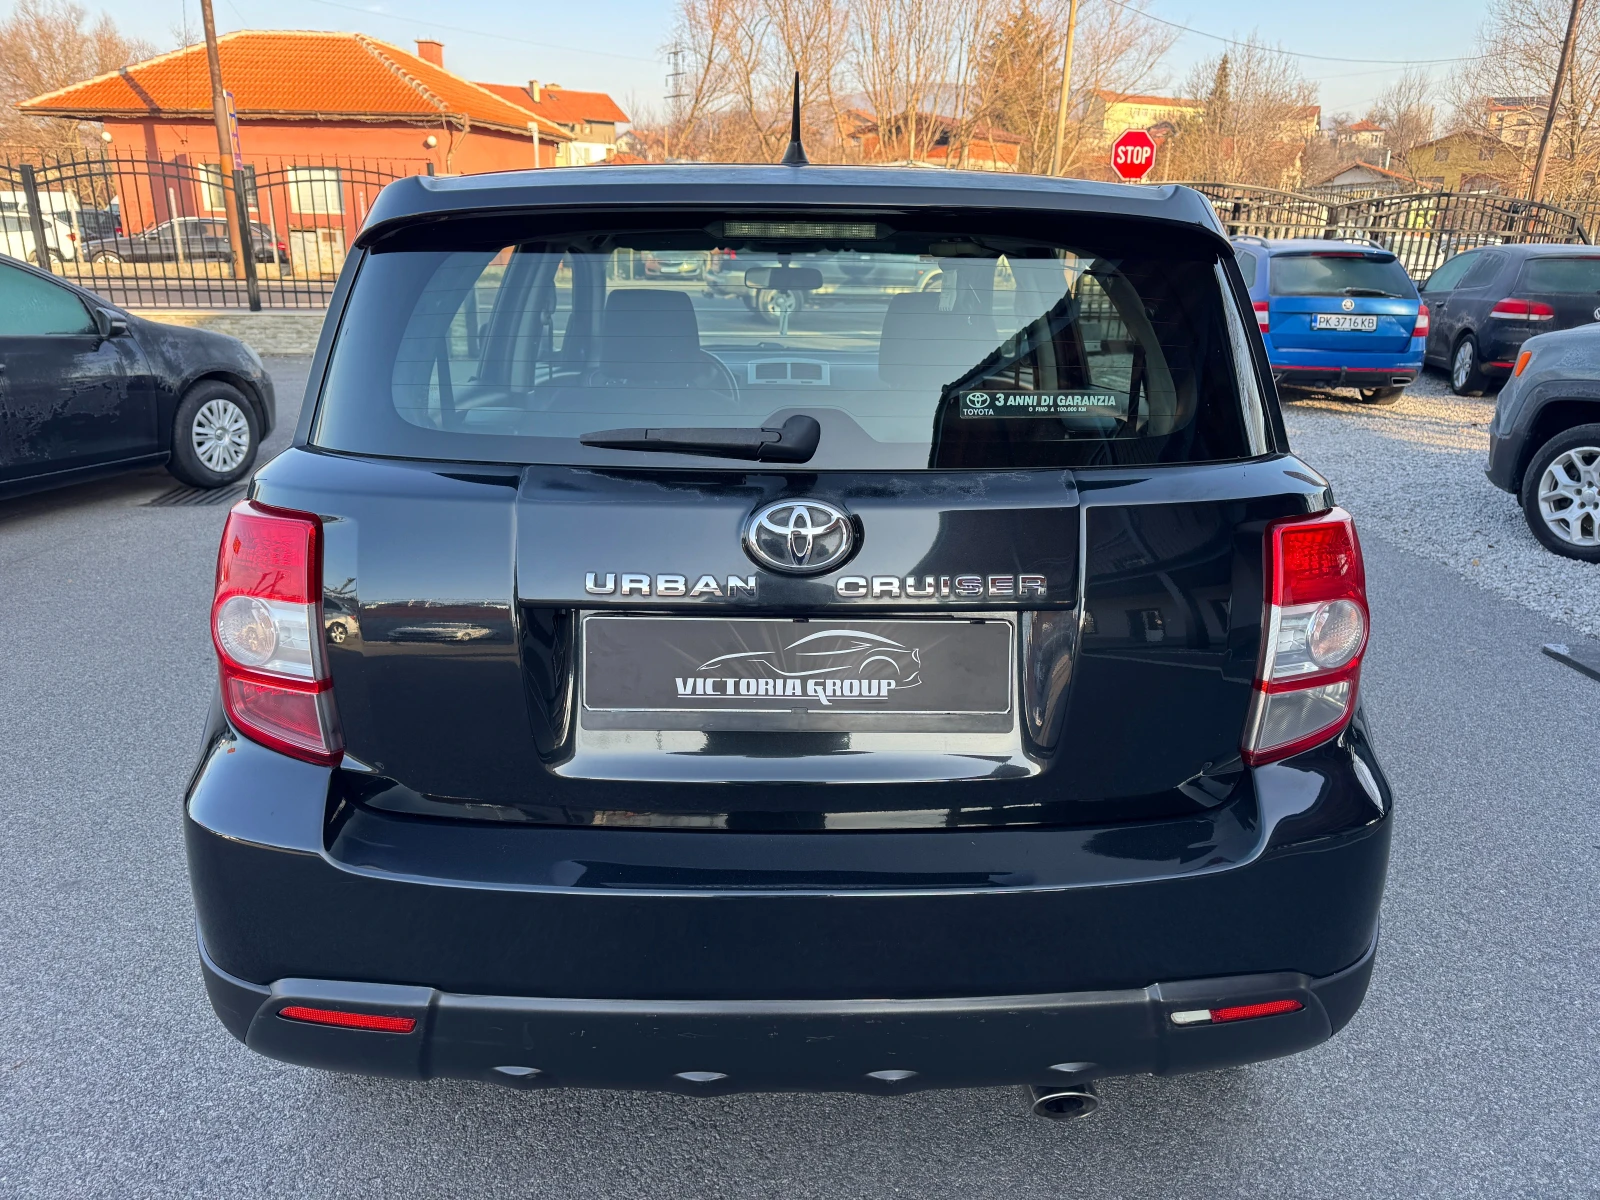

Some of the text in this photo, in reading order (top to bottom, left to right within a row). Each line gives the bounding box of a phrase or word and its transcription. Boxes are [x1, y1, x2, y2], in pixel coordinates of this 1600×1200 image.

[1116, 145, 1151, 164] STOP
[1318, 316, 1375, 328] PK 3716 KB
[995, 393, 1116, 406] 3 ANNI DI GARANZIA
[962, 408, 994, 416] TOYOTA
[584, 571, 1048, 598] URBAN CRUISER
[675, 677, 896, 706] VICTORIA GROUP
